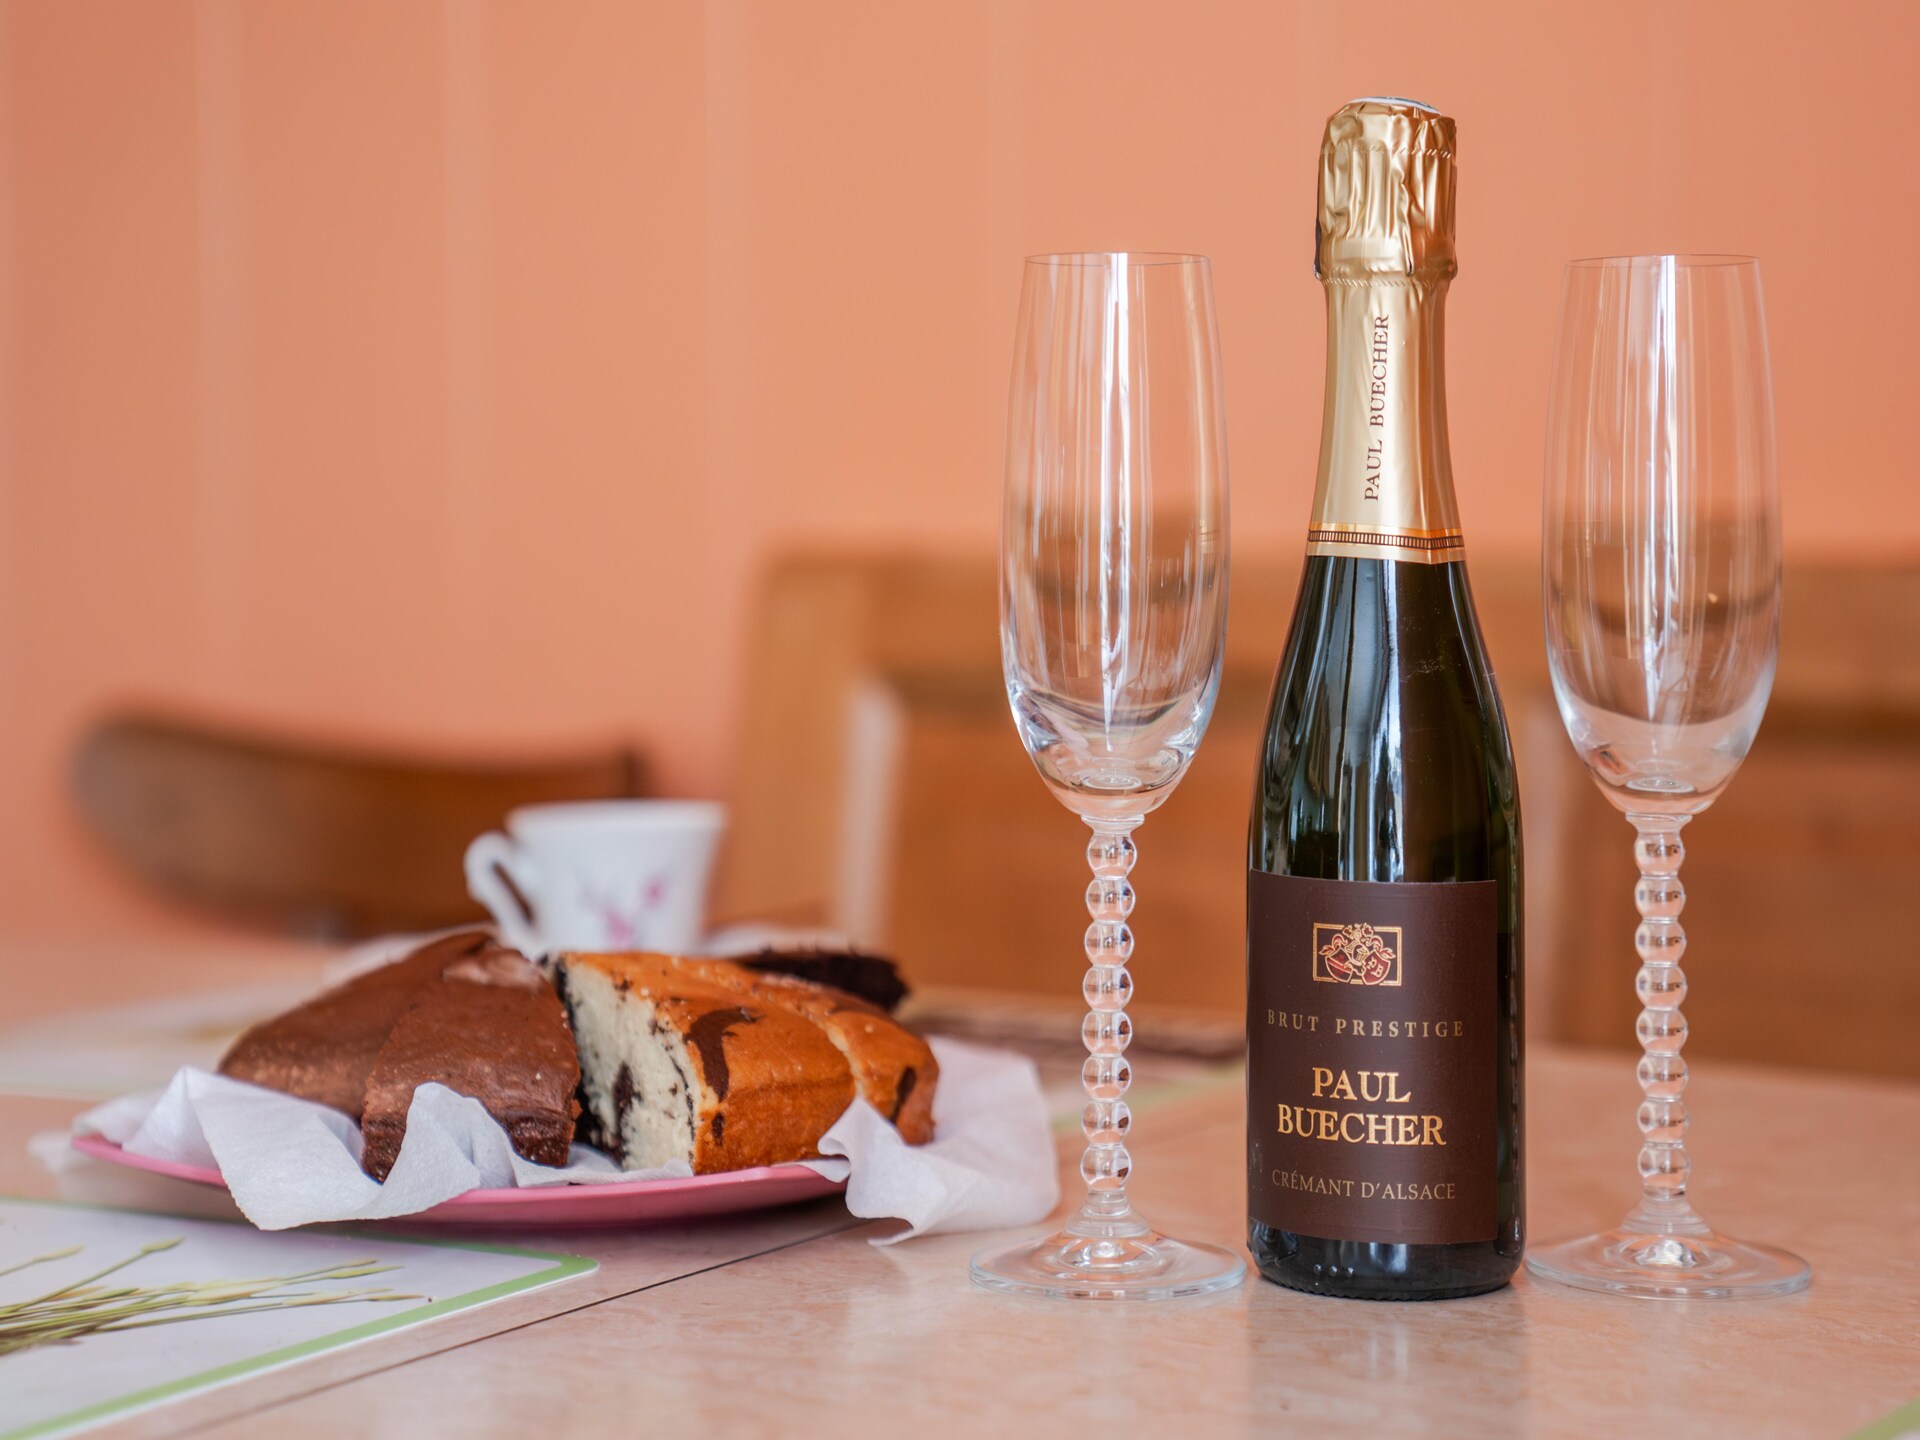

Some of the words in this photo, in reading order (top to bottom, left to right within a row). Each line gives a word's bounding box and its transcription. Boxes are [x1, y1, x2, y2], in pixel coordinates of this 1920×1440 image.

[1369, 314, 1390, 428] BUECHER
[1364, 439, 1383, 502] PAUL
[1267, 1009, 1319, 1032] BRUT
[1335, 1019, 1463, 1038] PRESTIGE
[1312, 1067, 1411, 1103] PAUL
[1277, 1104, 1446, 1146] BUECHER
[1272, 1170, 1355, 1197] CRÉMANT
[1361, 1182, 1455, 1201] D'ALSACE
